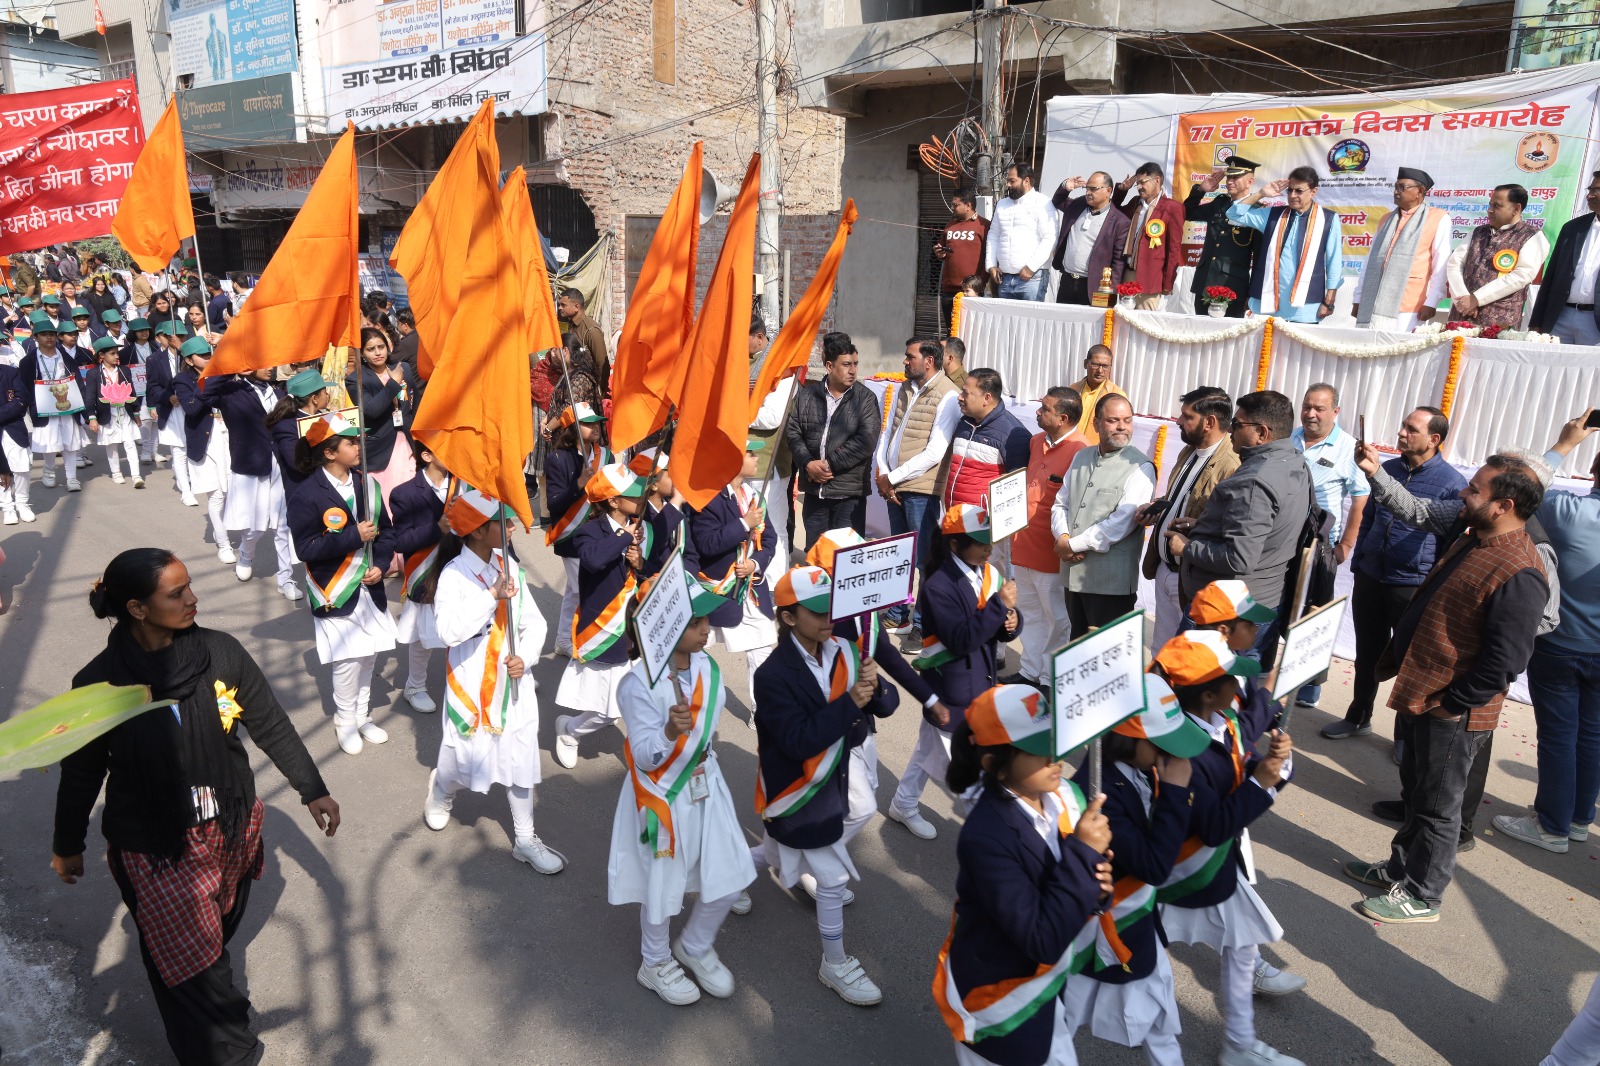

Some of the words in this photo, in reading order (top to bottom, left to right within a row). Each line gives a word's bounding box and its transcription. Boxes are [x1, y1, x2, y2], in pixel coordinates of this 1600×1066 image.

[2, 105, 58, 128] चरण
[189, 100, 227, 118] Thyrocare
[1190, 125, 1215, 143] 77
[1254, 113, 1345, 139] गणतंत्र
[1353, 110, 1434, 134] दिवस
[1442, 101, 1571, 131] समारोह
[5, 175, 35, 201] हित
[39, 164, 83, 191] जीना
[89, 158, 134, 186] होगा
[1433, 189, 1452, 198] बाल
[1453, 189, 1487, 198] कल्याण
[49, 206, 73, 224] नव
[75, 198, 120, 221] रचना
[1339, 210, 1367, 225] मारे
[946, 230, 975, 241] BOSS
[850, 549, 865, 564] वंदे
[837, 573, 867, 591] भारत
[869, 567, 893, 583] माता
[896, 559, 911, 577] की
[1055, 668, 1076, 695] हम
[1078, 655, 1099, 679] सब
[1102, 642, 1123, 669] एक
[1064, 693, 1084, 720] वंदे
